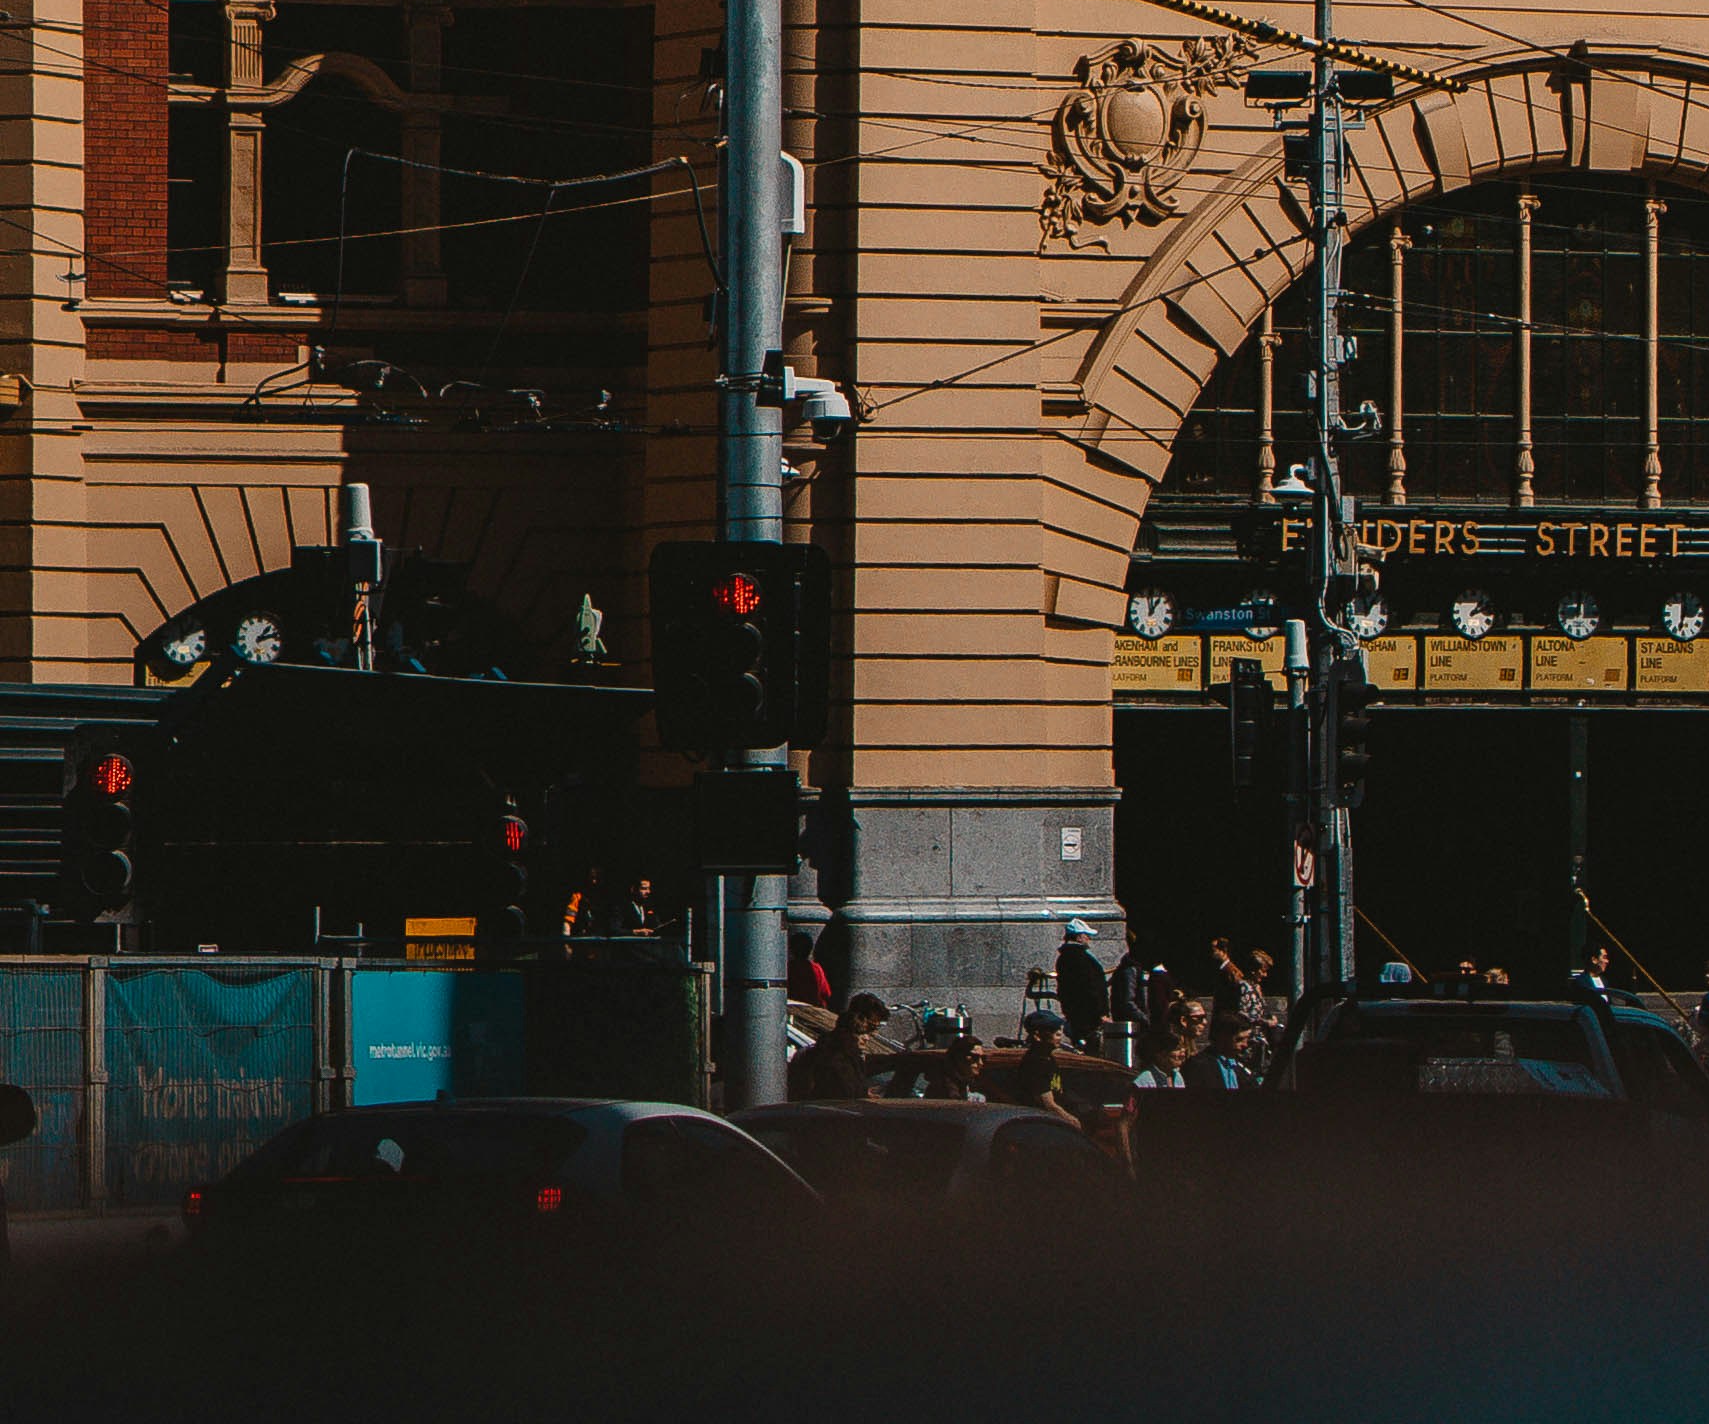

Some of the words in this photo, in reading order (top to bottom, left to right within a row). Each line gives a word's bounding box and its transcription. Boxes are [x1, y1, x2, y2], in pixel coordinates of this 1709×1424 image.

[1281, 518, 1479, 555] FDERS
[1536, 521, 1686, 557] STREET
[1114, 639, 1158, 652] AKENHAM
[1162, 640, 1179, 652] and
[1212, 639, 1274, 652] FRANKSTON
[1430, 639, 1507, 652] WILLIAMSTOWN
[1535, 639, 1576, 652] ALTONA
[1640, 642, 1655, 654] ST
[1655, 642, 1695, 654] ALBANS
[1112, 655, 1172, 668] RANBOURNE
[1173, 655, 1200, 668] LINES
[1430, 655, 1452, 668] LINE
[1535, 655, 1558, 667] LINE
[1640, 657, 1663, 669] LINE
[1112, 673, 1147, 681] LATFORM
[1429, 673, 1468, 682] PLATFORM
[1535, 673, 1574, 682] PLATFORM
[1640, 675, 1678, 683] PLATFORM
